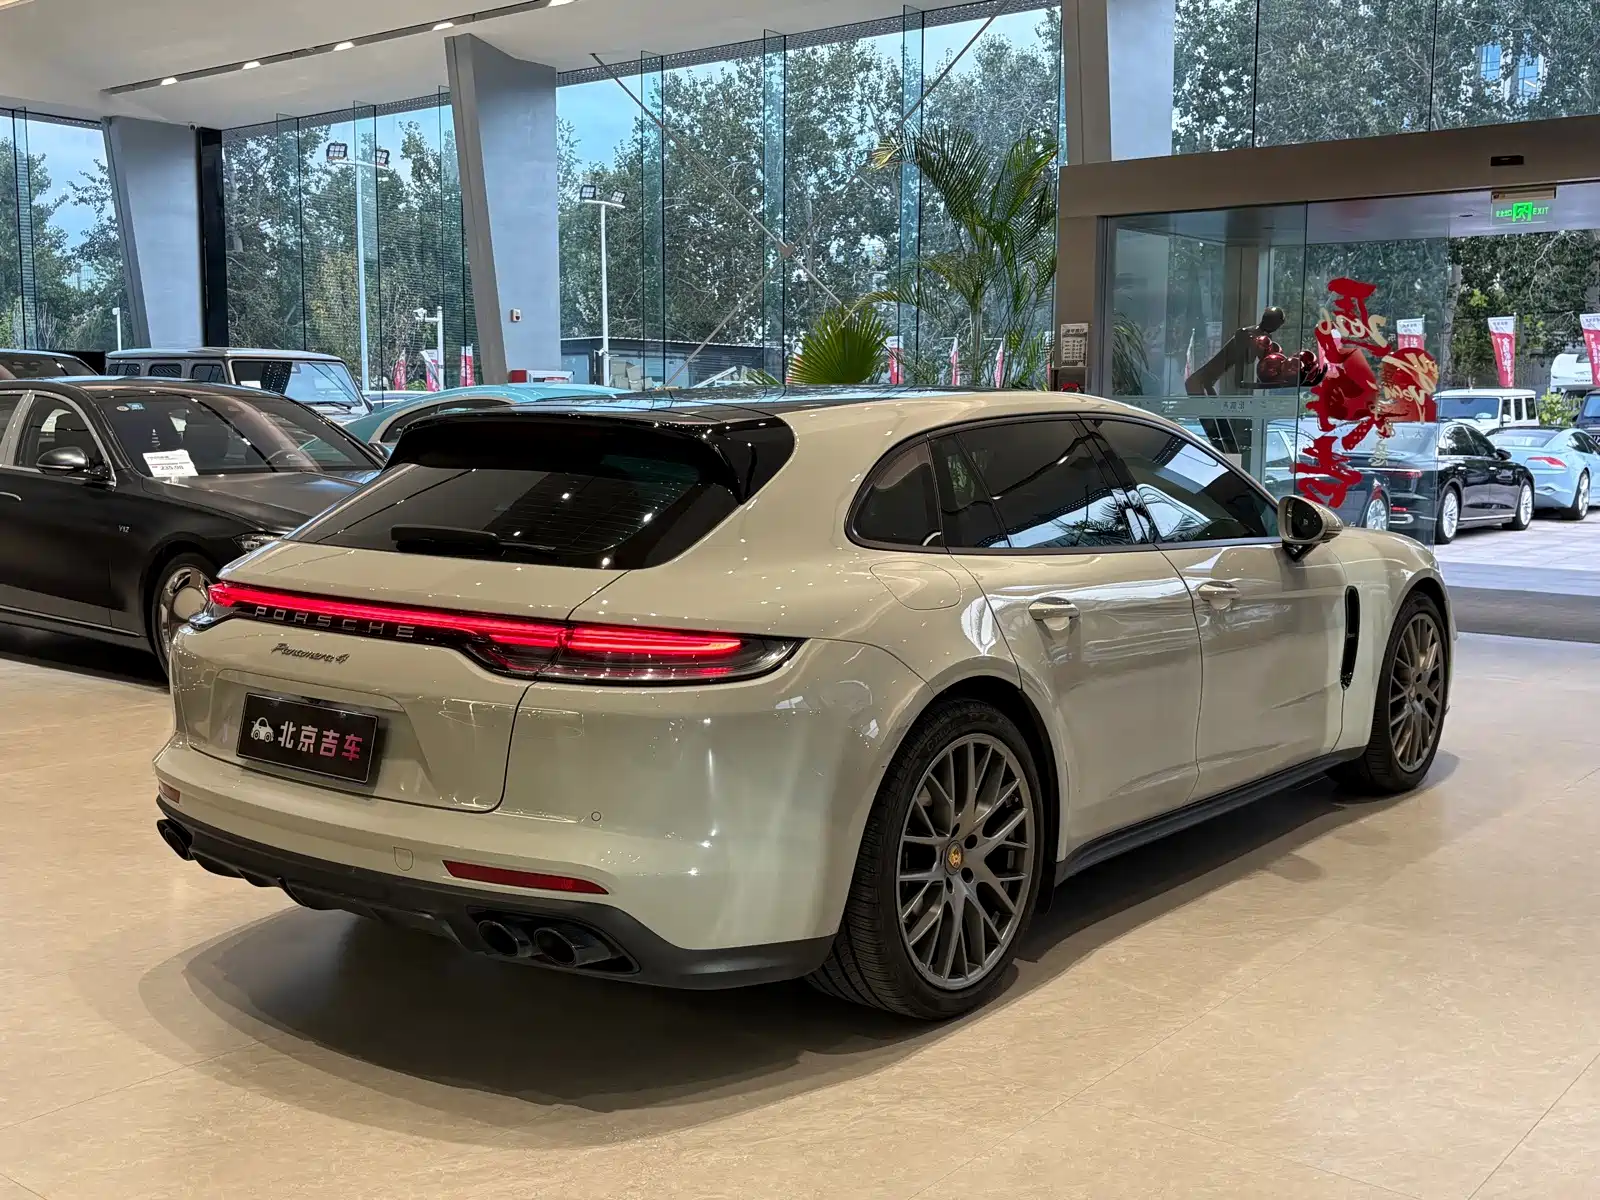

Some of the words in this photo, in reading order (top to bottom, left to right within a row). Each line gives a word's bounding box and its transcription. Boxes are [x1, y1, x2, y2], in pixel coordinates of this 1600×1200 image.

[1532, 206, 1549, 215] EXIT
[254, 606, 415, 638] PORSCHE
[271, 642, 334, 663] Panamera
[335, 652, 350, 665] 4
[277, 720, 363, 761] 北京吉车
